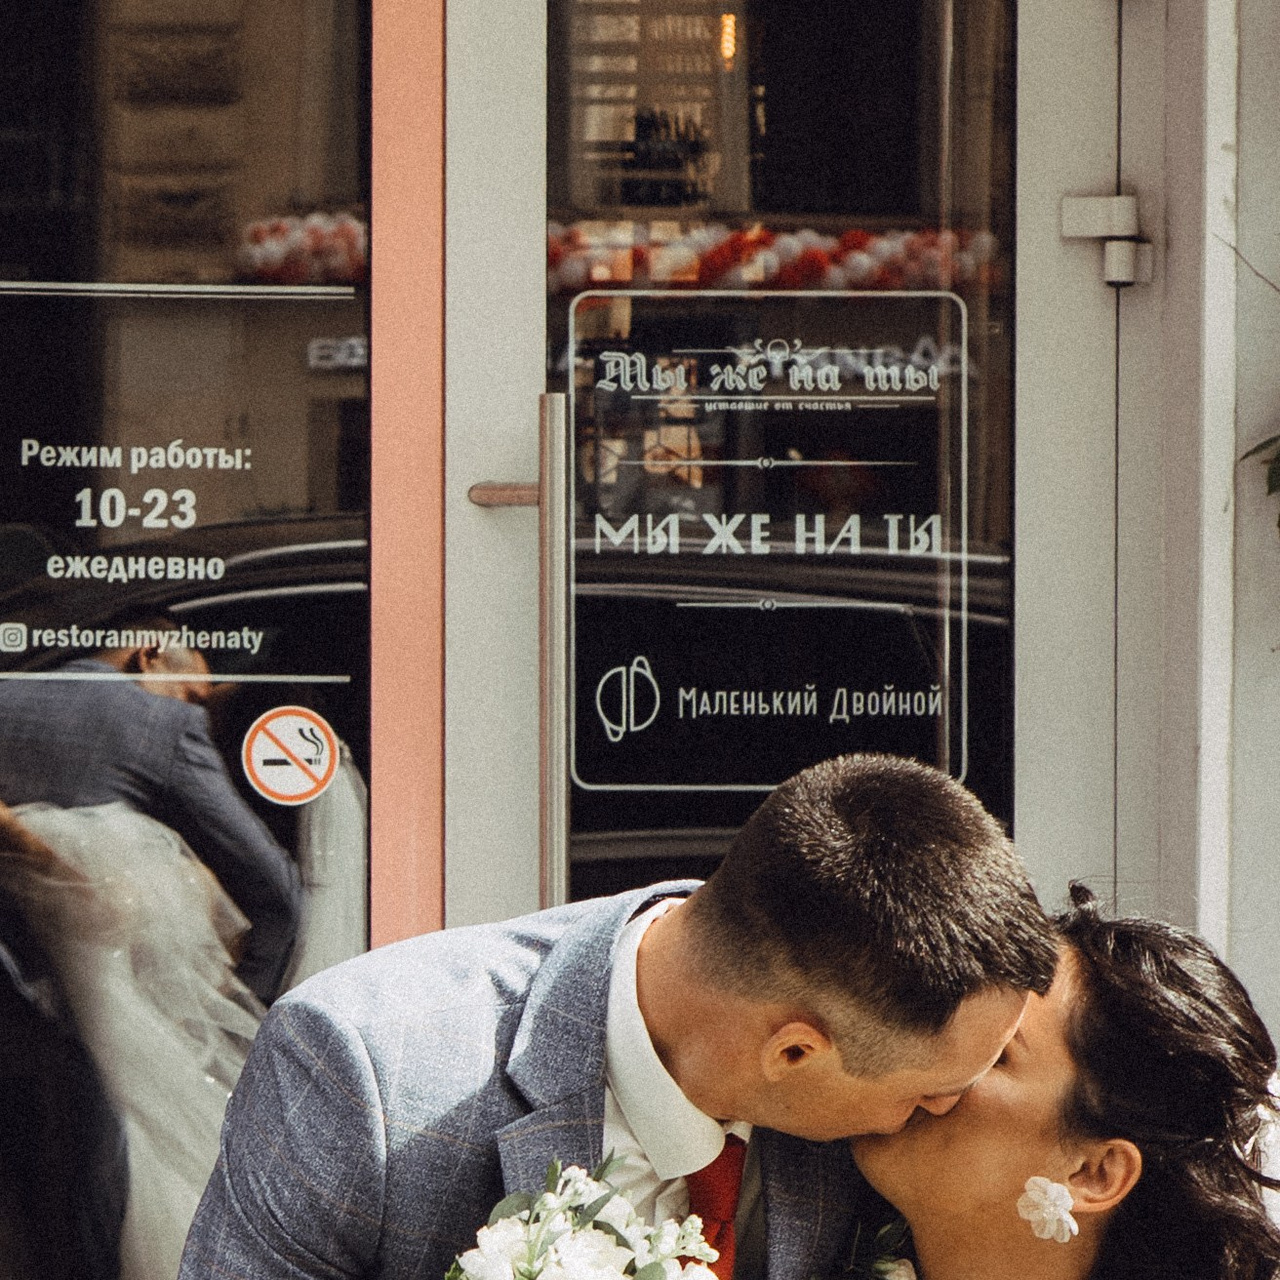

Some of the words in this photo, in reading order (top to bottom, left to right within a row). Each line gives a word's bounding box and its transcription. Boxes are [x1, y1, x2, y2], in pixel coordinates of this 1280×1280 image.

[596, 351, 688, 392] Мы
[710, 363, 768, 392] же
[789, 363, 842, 392] на
[863, 363, 941, 392] ты
[21, 438, 122, 468] Режим
[130, 438, 252, 474] работы:
[75, 487, 197, 529] 10-23
[594, 512, 680, 555] МЫ
[701, 513, 771, 555] ЖЕ
[795, 513, 861, 555] НА
[883, 514, 942, 557] ТЫ
[46, 554, 226, 584] ежедневно
[31, 624, 264, 655] restoranmyzhenaty
